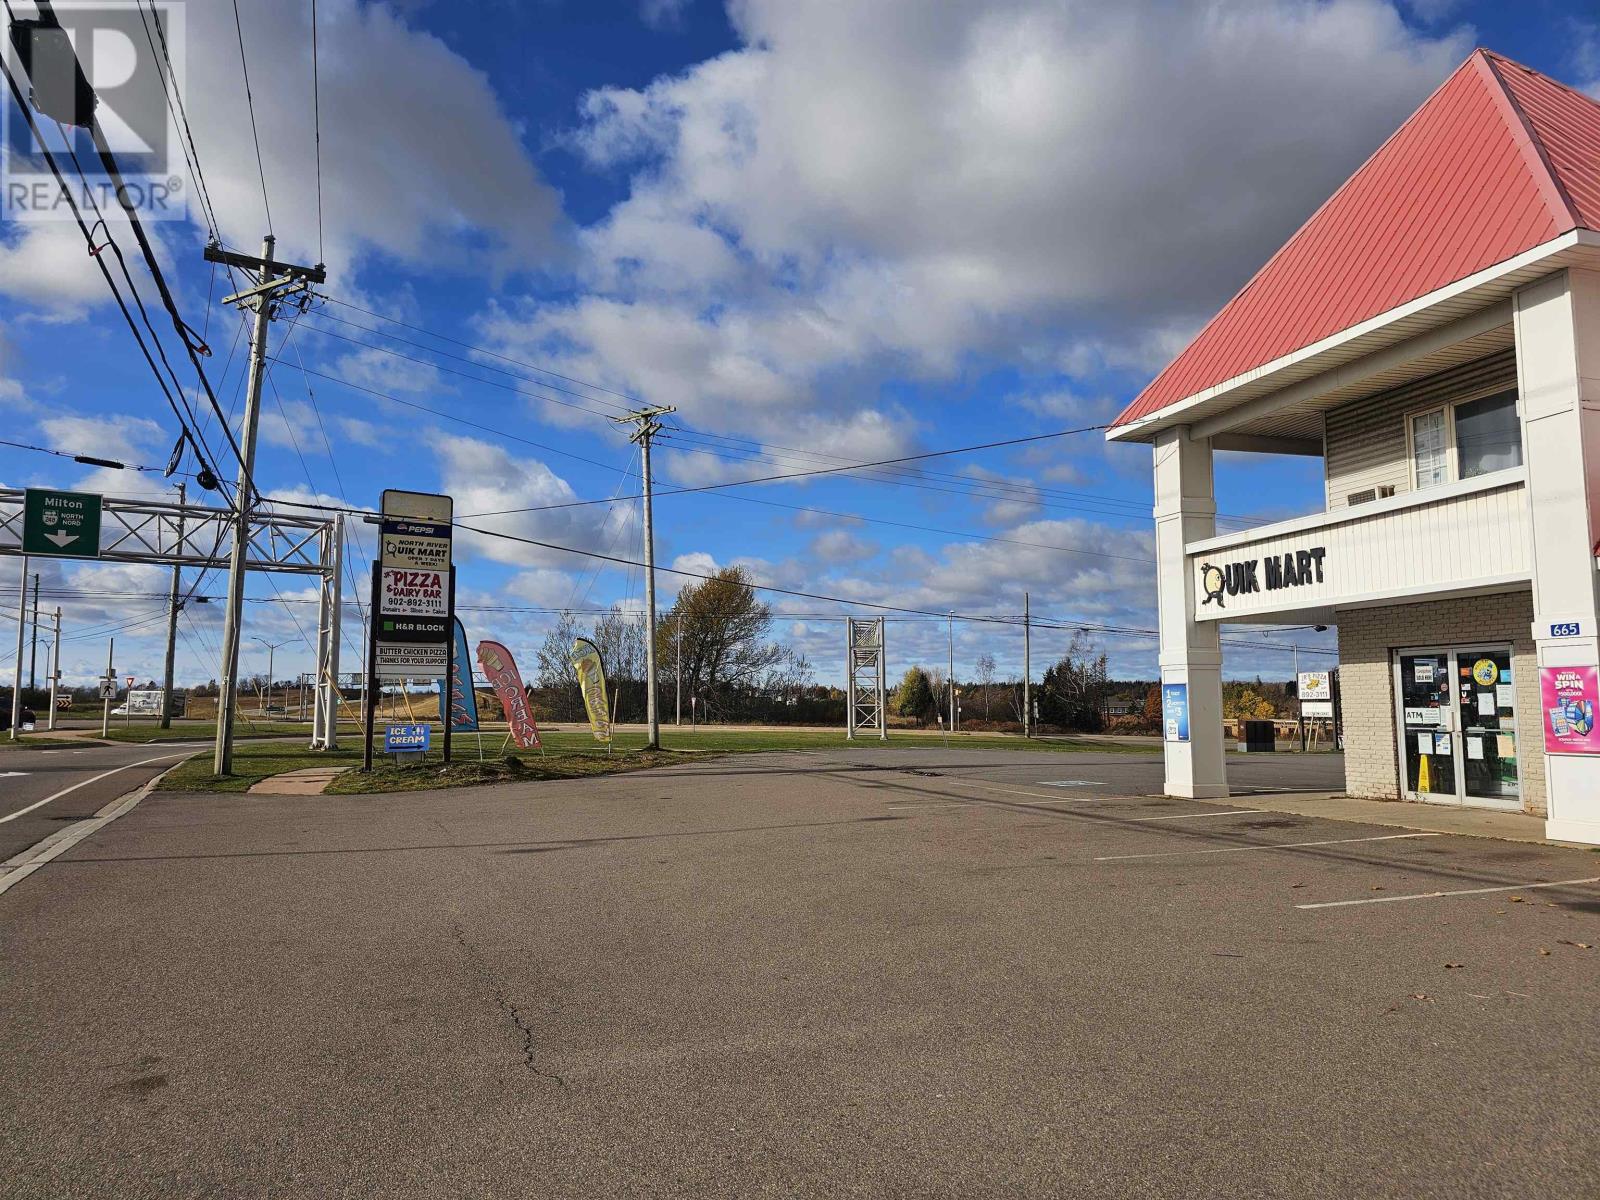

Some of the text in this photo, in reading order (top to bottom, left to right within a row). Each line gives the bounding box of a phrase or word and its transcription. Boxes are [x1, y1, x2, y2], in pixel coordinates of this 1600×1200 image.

[44, 497, 83, 508] Milton
[408, 525, 434, 534] PEPSI
[417, 549, 447, 557] MART
[1264, 547, 1326, 590] MART
[393, 571, 441, 589] PIZZA
[387, 584, 441, 599] & DAIRY BAR
[388, 597, 442, 607] 902-892-3111
[1553, 624, 1577, 635] 665
[1554, 680, 1584, 690] SPIN
[390, 727, 407, 735] ICE
[390, 736, 425, 744] CREAM
